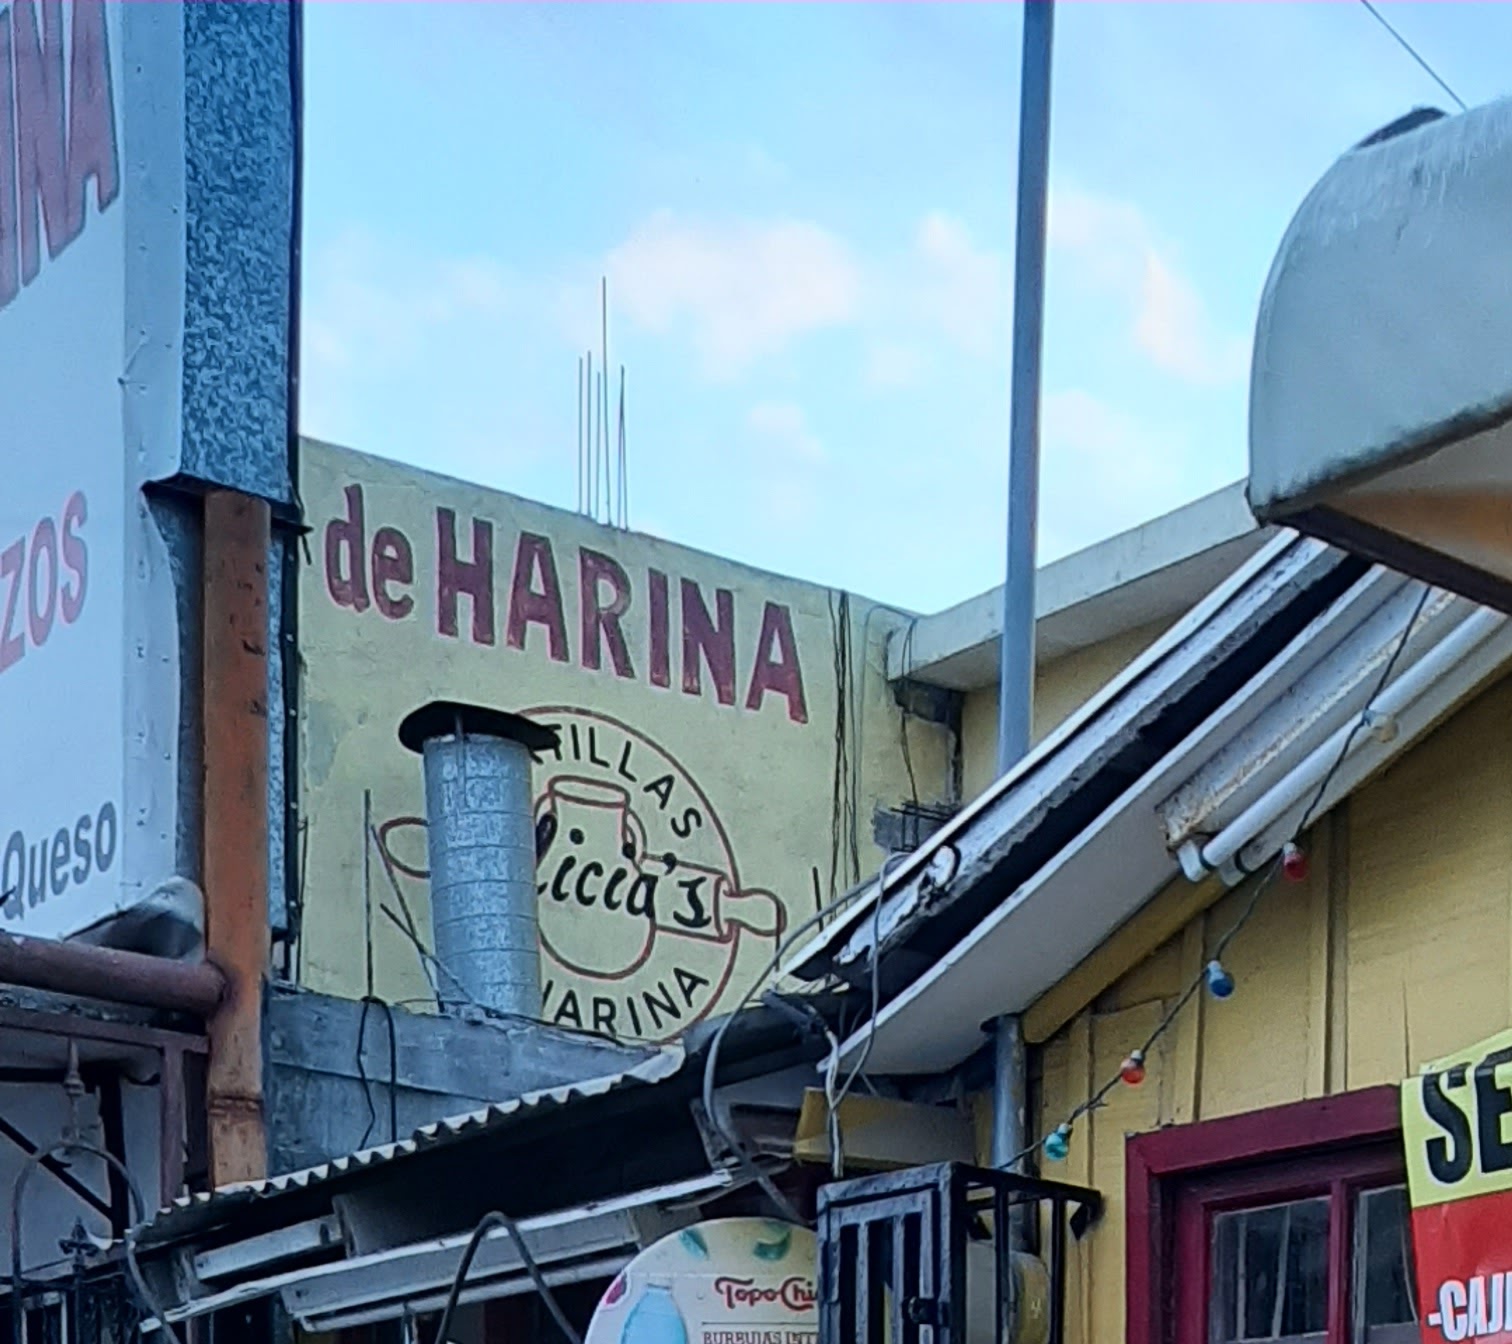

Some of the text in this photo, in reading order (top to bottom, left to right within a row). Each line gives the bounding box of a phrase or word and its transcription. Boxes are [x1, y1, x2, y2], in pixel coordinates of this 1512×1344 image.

[325, 483, 809, 725] de HARINA
[531, 723, 702, 838] ILLAS
[2, 801, 117, 920] Queso
[779, 1276, 818, 1312] Chi
